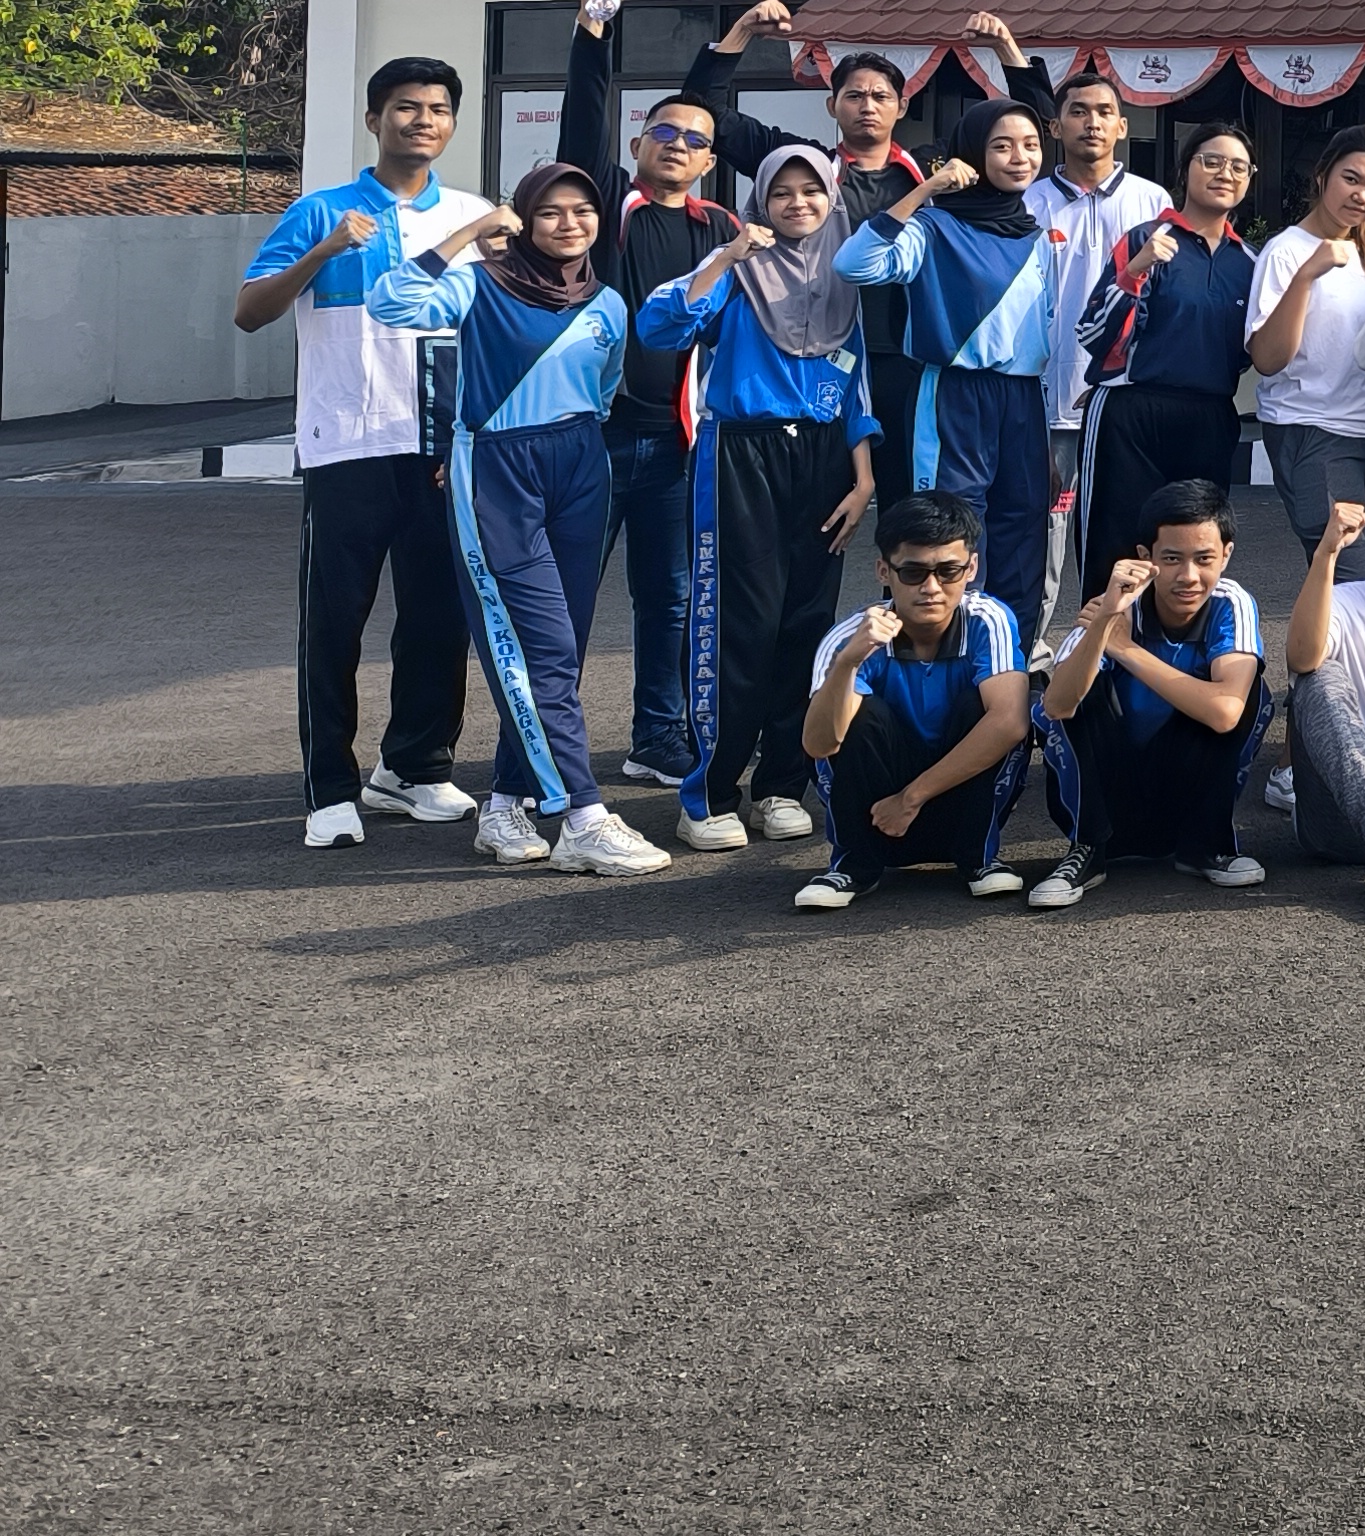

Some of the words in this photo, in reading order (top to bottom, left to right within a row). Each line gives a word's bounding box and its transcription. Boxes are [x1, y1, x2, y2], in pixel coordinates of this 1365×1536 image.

[494, 628, 520, 684] KOTA
[509, 686, 541, 756] TEGAL
[696, 624, 717, 680] KOTA
